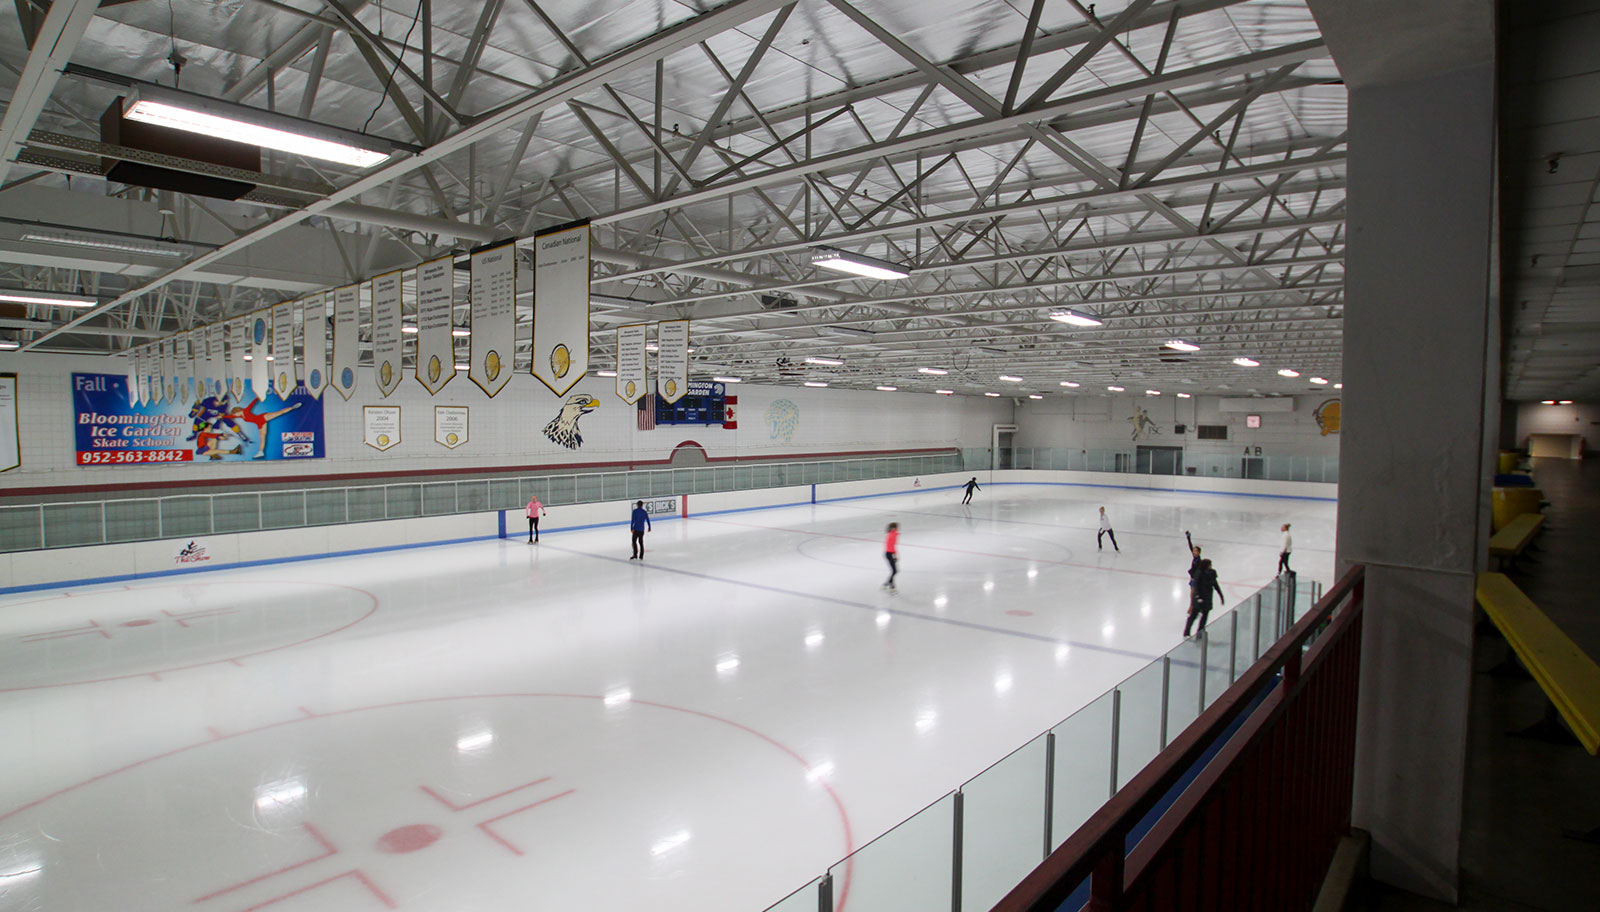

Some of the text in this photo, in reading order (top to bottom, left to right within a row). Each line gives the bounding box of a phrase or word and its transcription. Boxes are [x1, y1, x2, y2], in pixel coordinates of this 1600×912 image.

[542, 234, 582, 250] Canadian National
[487, 254, 503, 263] National
[76, 376, 107, 391] Fall
[79, 412, 187, 426] Bloomington
[91, 425, 182, 437] Ice Garden
[92, 437, 175, 448] Skate School
[82, 450, 184, 464] 952-563-8842
[1243, 446, 1263, 456] A B
